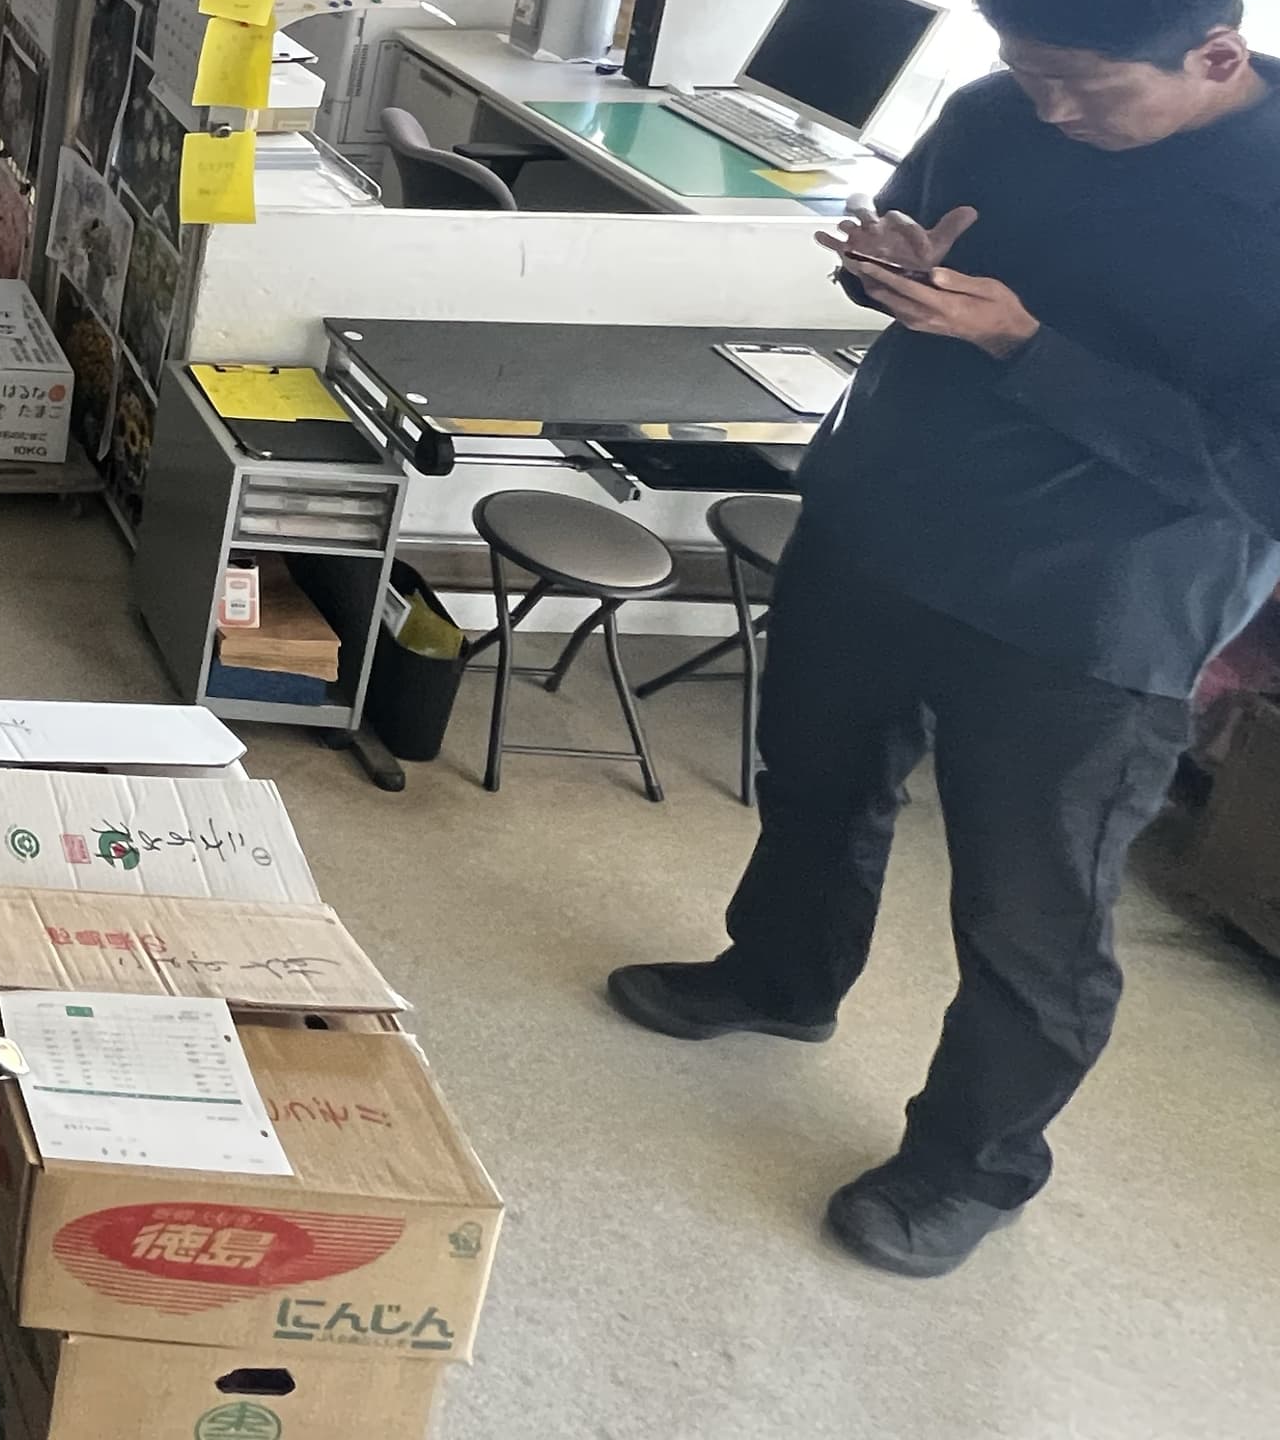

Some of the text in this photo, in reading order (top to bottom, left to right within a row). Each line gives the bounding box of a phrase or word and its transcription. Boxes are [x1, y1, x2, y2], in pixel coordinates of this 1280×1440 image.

[2, 384, 47, 400] はるな
[18, 404, 65, 419] たまご
[13, 446, 49, 458] 10KG
[130, 1221, 278, 1269] 徳島
[274, 1296, 456, 1340] にんじん
